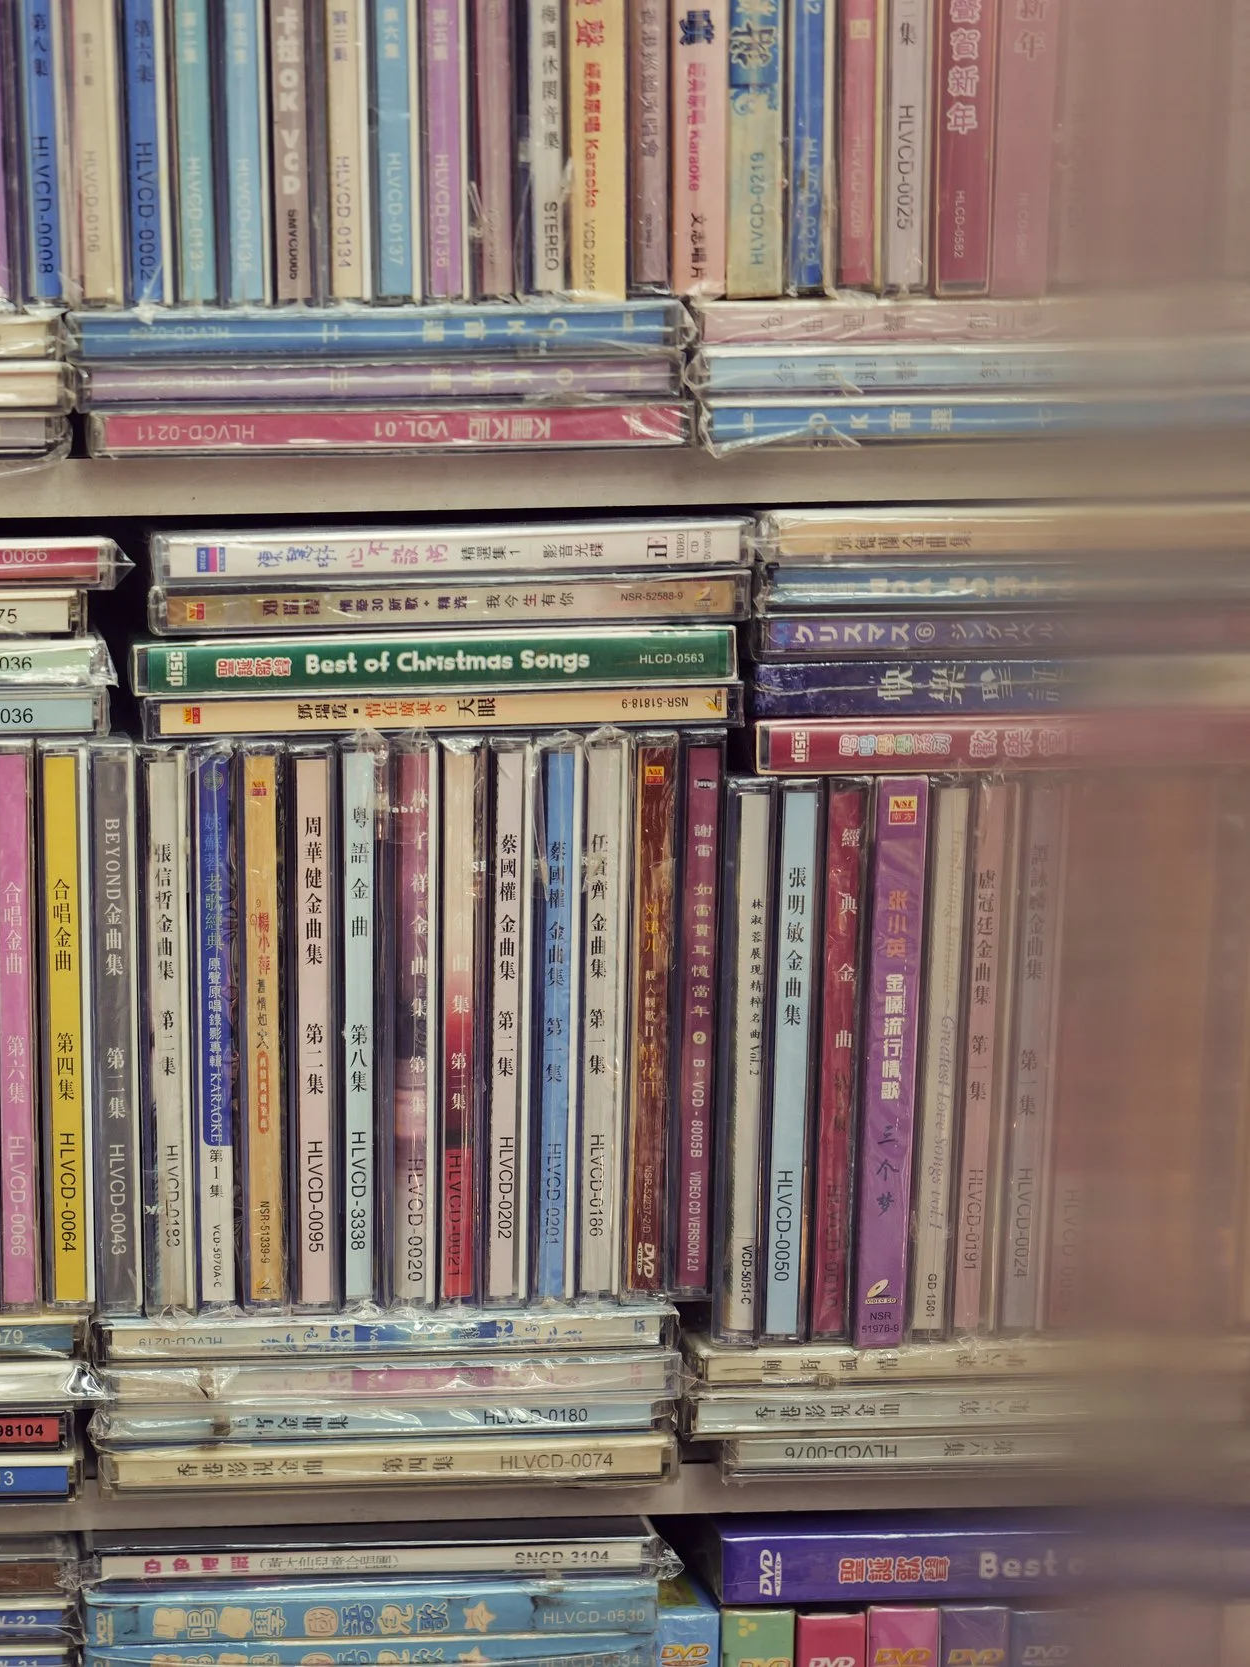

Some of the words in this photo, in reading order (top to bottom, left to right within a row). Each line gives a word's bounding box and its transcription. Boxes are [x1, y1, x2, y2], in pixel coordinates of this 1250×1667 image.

[134, 19, 153, 84] 第六集
[279, 129, 301, 196] VCD
[584, 139, 601, 208] Karaoke
[897, 104, 915, 230] HLVCD-0025
[135, 142, 156, 279] HLVCD-0002
[386, 153, 405, 266] HLVCD-0137
[544, 201, 559, 271] STEREO
[749, 151, 766, 265] HLVCD-0219
[136, 423, 256, 442] HLVCD-0211
[375, 420, 449, 440] VOL.01
[542, 541, 605, 559] 影音光碟
[690, 540, 700, 554] CD
[486, 591, 576, 609] 我今生有你
[620, 590, 684, 602] NSR-52588-9
[792, 620, 911, 645] クリスマス
[305, 653, 358, 675] Best
[363, 650, 390, 673] of
[397, 649, 514, 674] Christmas
[519, 649, 591, 674] Songs
[638, 652, 706, 665] HLCD-0563
[457, 696, 496, 717] 天眼
[621, 696, 689, 709] NSR-51818-9
[52, 878, 72, 972] 合唱金曲
[154, 843, 175, 981] 張信哲金曲集
[304, 815, 324, 967] 周華健金曲集
[498, 834, 518, 982] 蔡國權金曲集
[547, 841, 566, 988] 蔡國權金曲集
[2, 881, 24, 976] 合唱金曲
[691, 882, 713, 1019] 如雷貫耳憶當年
[784, 866, 807, 1028] 張明敏金曲集
[835, 828, 861, 1049] 經典金曲
[974, 869, 996, 1006] 盧冠廷金曲集
[6, 1035, 26, 1104] 第六集
[57, 1032, 76, 1101] 第四集
[160, 1010, 177, 1077] 第二集
[306, 1022, 325, 1095] 第二集
[350, 1024, 368, 1092] 第八集
[496, 1018, 514, 1078] 第二集
[588, 1008, 606, 1074] 第一集
[880, 974, 905, 1100] 金嗓流行情歌
[969, 1034, 989, 1102] 第一集
[107, 1046, 127, 1119] 第二集
[209, 1072, 224, 1143] KARAOKE
[1017, 1049, 1040, 1117] 第一集
[9, 1135, 27, 1257] HLVCD-0066
[60, 1132, 77, 1253] HLVCD-0064
[109, 1144, 127, 1256] HLVCD-0043
[307, 1141, 325, 1253] HLVCD-0095
[350, 1131, 367, 1251] HLVCD-3338
[446, 1155, 463, 1277] HLVCD-0021
[497, 1136, 514, 1239] HLVCD-0202
[546, 1143, 562, 1246] HLVCD-0201
[689, 1170, 702, 1200] VIDEO
[964, 1168, 985, 1270] HLVCD-0191
[259, 1200, 272, 1264] NSR-51339-9
[408, 1158, 424, 1283] HLVCD-0020
[687, 1212, 700, 1256] VERSION
[774, 1170, 794, 1282] HLVCD-0050
[1013, 1167, 1035, 1279] HLVCD-0024
[643, 1242, 656, 1280] DVD
[740, 1244, 754, 1306] VCD-5051-C
[861, 1324, 901, 1335] 51976-9
[869, 1311, 893, 1322] NSR
[382, 1455, 455, 1474] 第四集
[499, 1452, 615, 1470] HLVCD-0074
[784, 1444, 899, 1460] HLVCD-0076
[758, 1548, 774, 1596] DVD
[978, 1551, 1057, 1580] Best
[542, 1610, 646, 1625] HLVCD-0530
[660, 1643, 712, 1661] DVD
[873, 1647, 934, 1666] DVD
